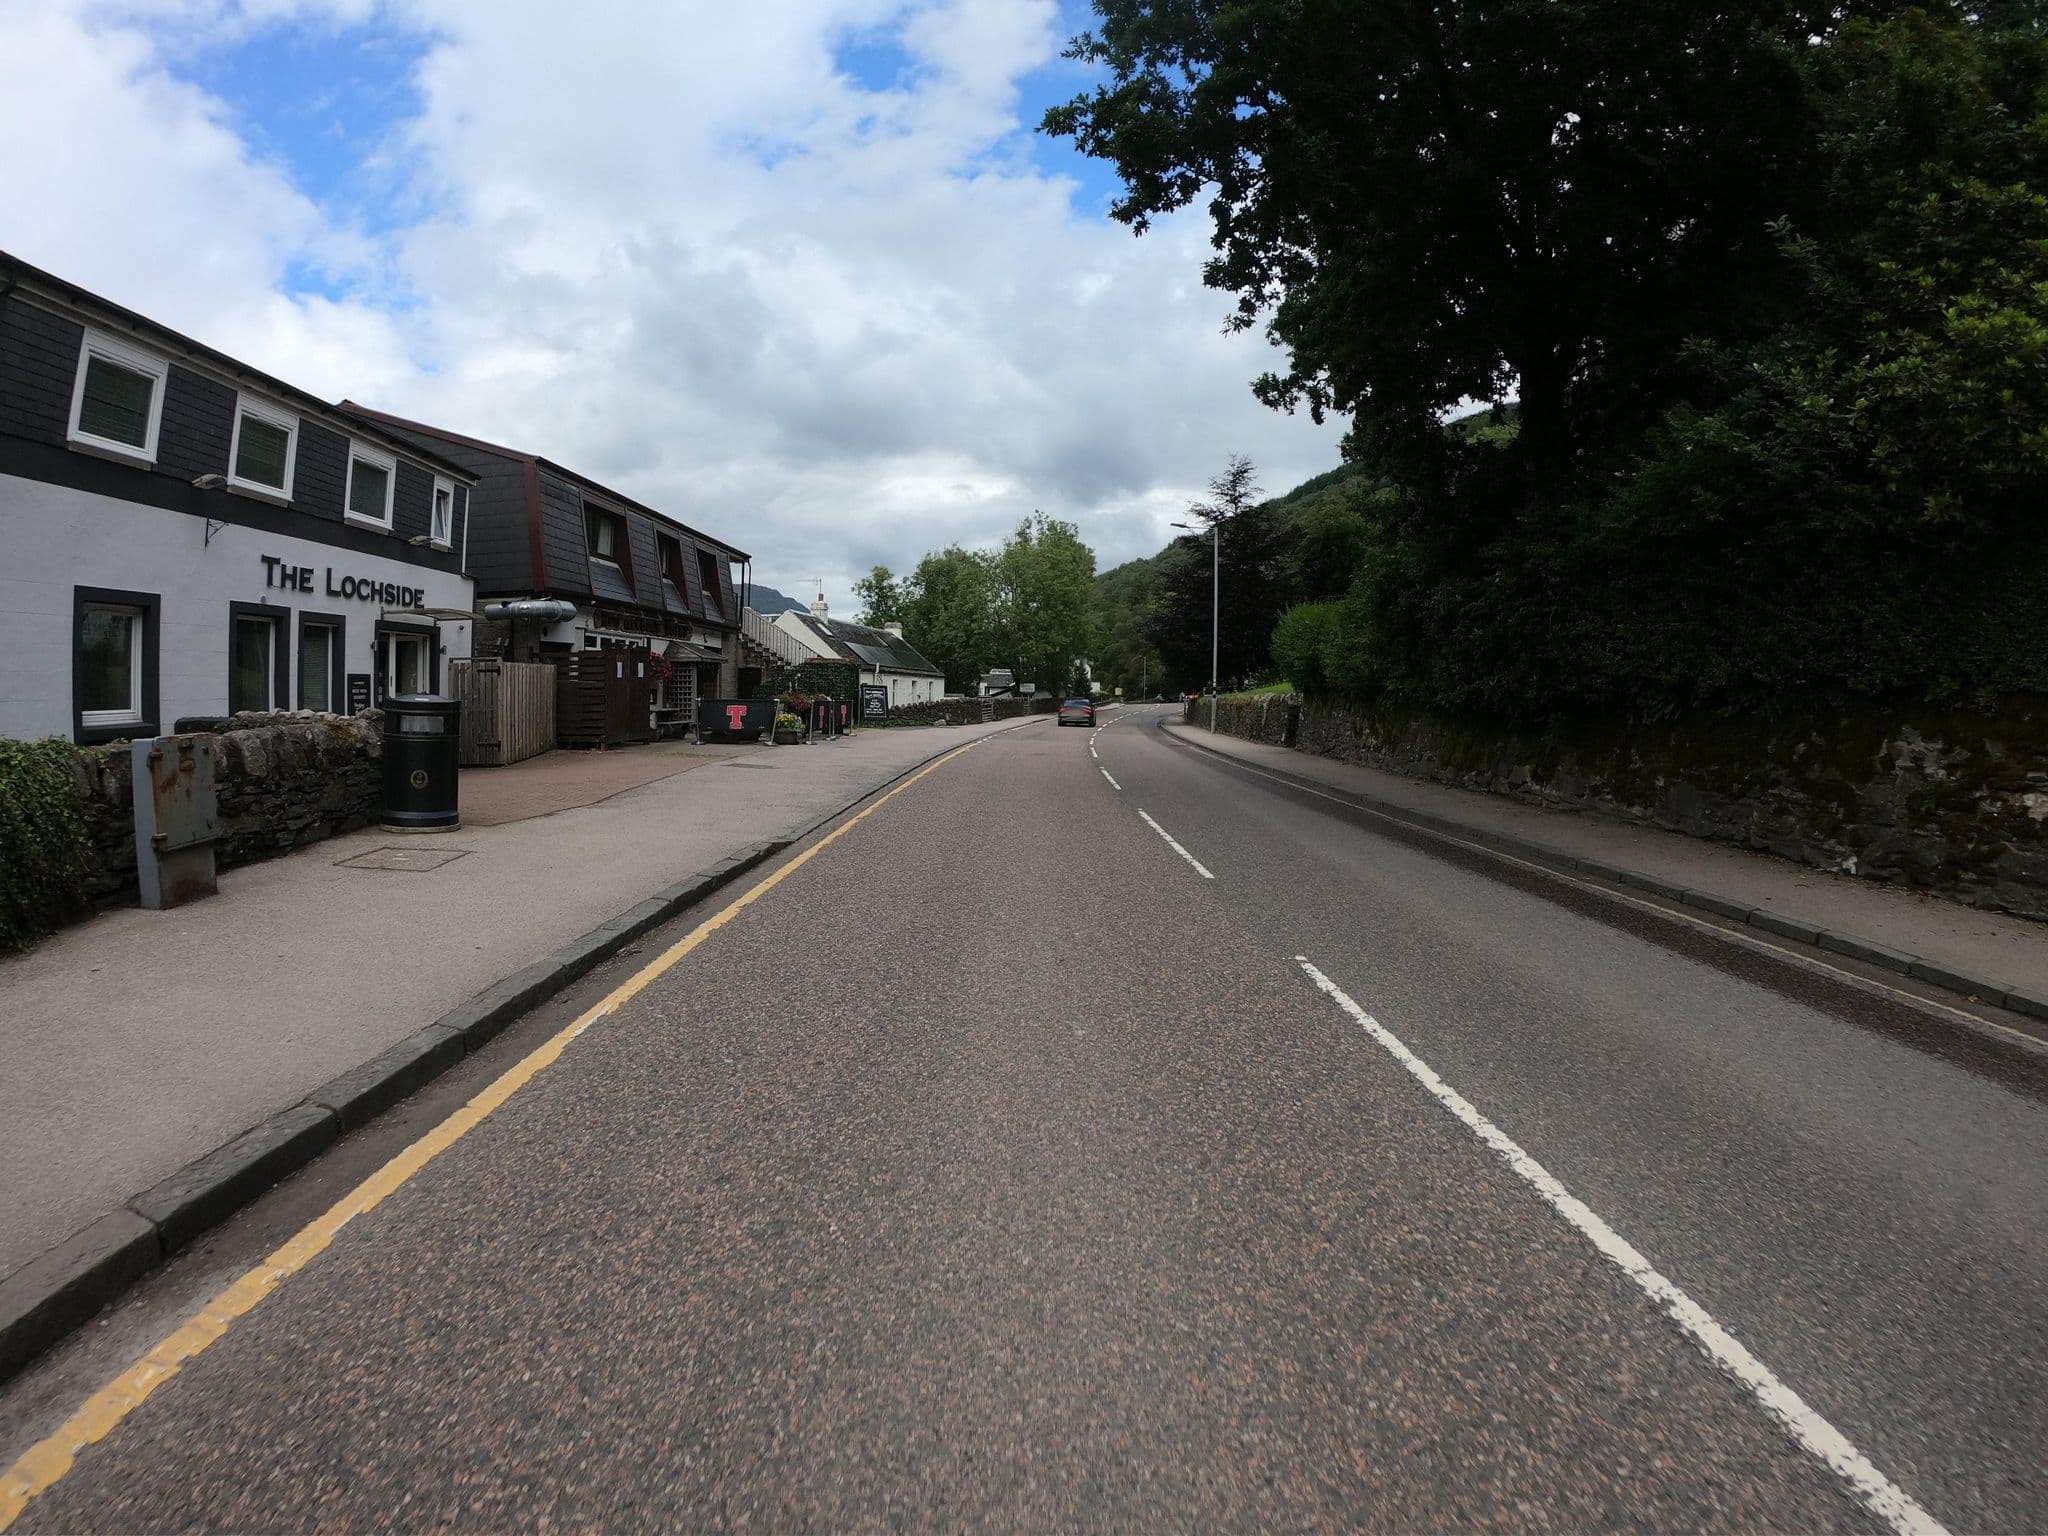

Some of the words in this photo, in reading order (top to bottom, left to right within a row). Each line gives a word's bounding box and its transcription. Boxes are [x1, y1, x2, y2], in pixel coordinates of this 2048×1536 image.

[261, 553, 314, 593] THE
[326, 567, 425, 609] LOCHSIDE
[726, 704, 748, 730] T
